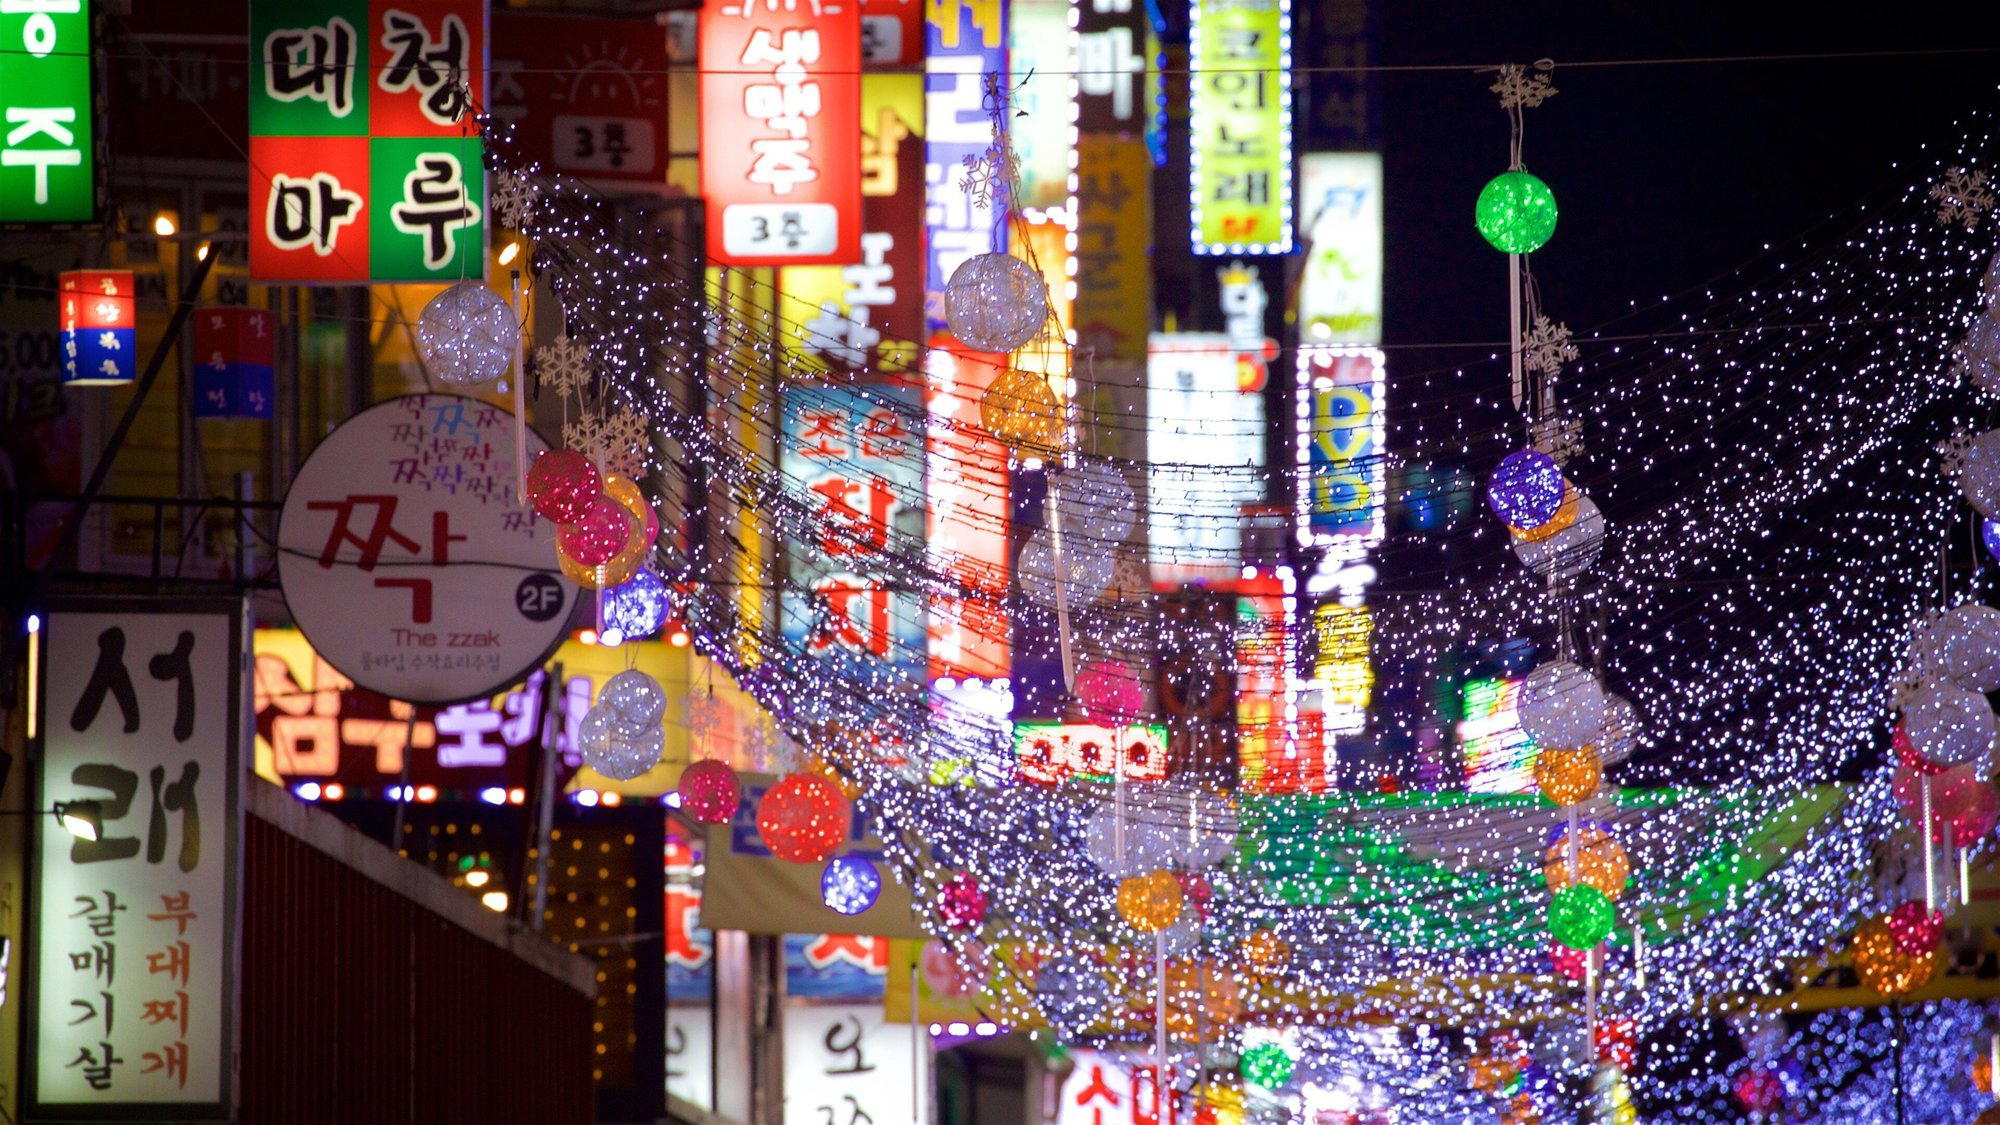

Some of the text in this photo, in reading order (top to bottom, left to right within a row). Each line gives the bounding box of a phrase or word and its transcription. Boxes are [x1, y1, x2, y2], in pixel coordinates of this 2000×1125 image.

[266, 12, 470, 124] 대청
[741, 28, 820, 195] 생맥주
[573, 124, 632, 168] 3층
[268, 155, 480, 268] 마루
[750, 211, 808, 248] 3층
[1313, 385, 1372, 515] DVD
[306, 495, 467, 624] 짝
[521, 586, 559, 611] 2F
[391, 628, 500, 648] The zzak
[69, 626, 200, 874] 서래
[67, 890, 127, 1091] 갈매기살
[139, 890, 198, 1090] 부대찌개
